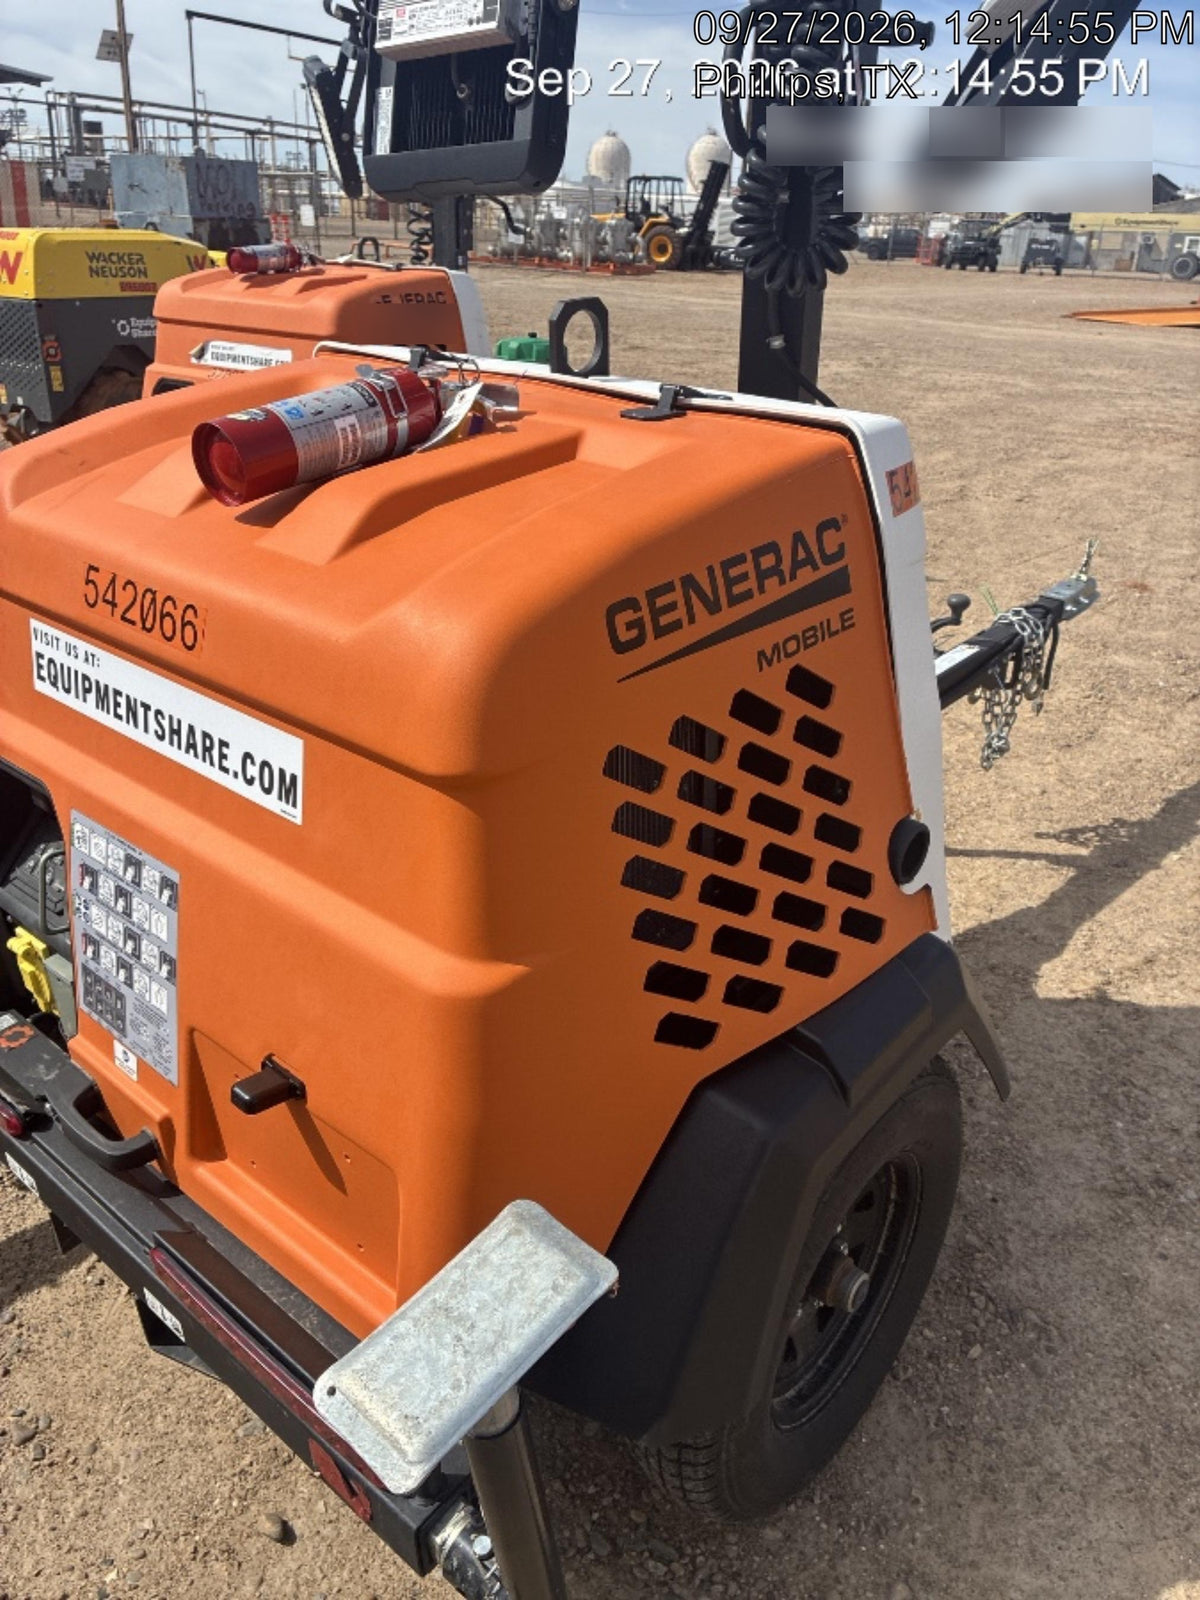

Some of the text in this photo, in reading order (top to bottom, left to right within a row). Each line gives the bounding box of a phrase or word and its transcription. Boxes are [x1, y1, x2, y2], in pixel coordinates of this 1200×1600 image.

[85, 251, 146, 265] WACKER
[88, 265, 148, 278] NEUSON
[84, 564, 199, 651] 542066
[606, 517, 846, 655] GENERAC
[33, 627, 100, 667] VISIT US AT:
[756, 608, 855, 673] MOBILE
[35, 651, 298, 808] EQUIPMENTSHARE.COM
